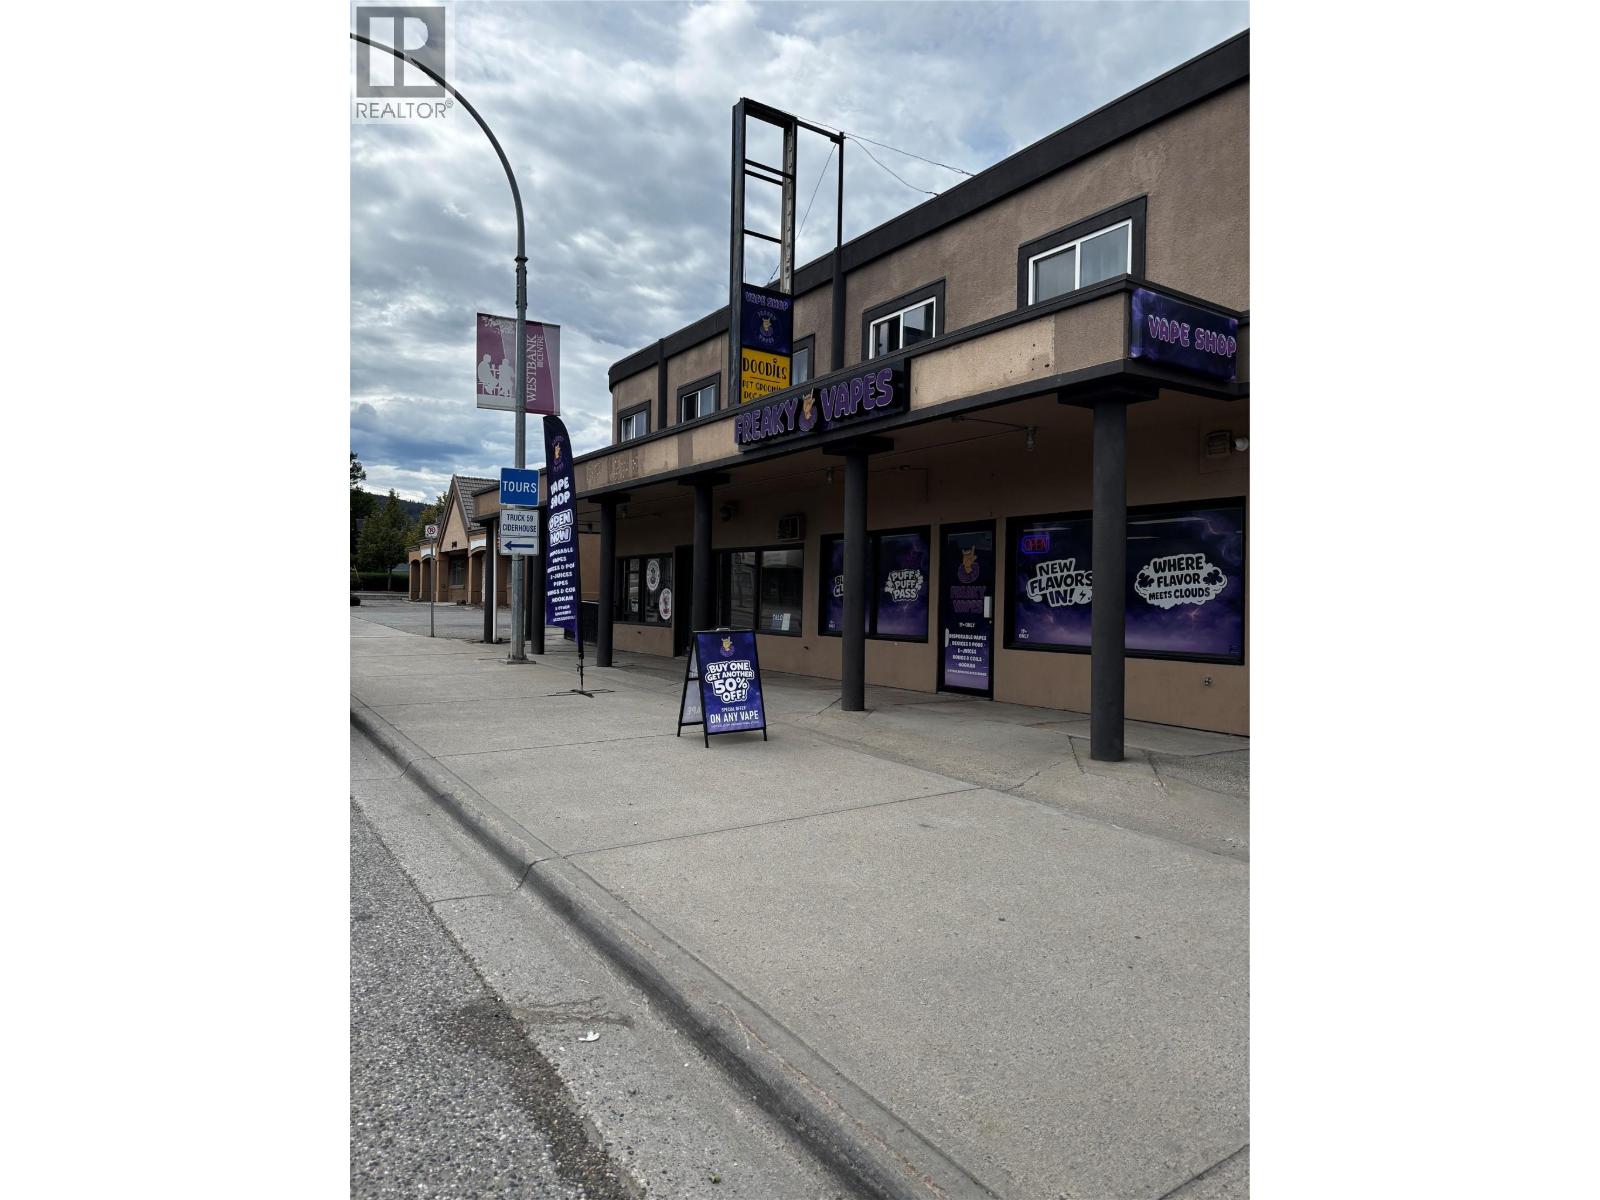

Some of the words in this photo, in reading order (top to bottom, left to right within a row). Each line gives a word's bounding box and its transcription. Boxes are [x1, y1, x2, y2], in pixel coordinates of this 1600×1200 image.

[1148, 314, 1190, 347] VAPE
[1195, 328, 1236, 358] SHOP
[536, 334, 544, 361] CENTRE
[526, 334, 537, 402] WESTBANK
[743, 380, 754, 389] PET
[735, 397, 798, 444] FREAKY
[820, 368, 894, 422] VAPES
[502, 480, 537, 493] TOURS
[507, 513, 525, 522] TRUCK
[549, 511, 571, 530] OPEN
[502, 524, 537, 533] CIDERHOUSE
[550, 528, 569, 545] NOW
[1024, 537, 1048, 551] OPEN
[1038, 560, 1073, 576] NEW
[1153, 555, 1204, 573] WHERE
[553, 579, 568, 587] PIPES
[894, 580, 915, 589] PUFF
[1029, 572, 1092, 594] FLAVORS
[1156, 572, 1200, 588] FLAVOR
[893, 588, 916, 599] PASS
[1048, 588, 1075, 605] IN!
[1148, 590, 1173, 601] MEETS
[1173, 587, 1211, 599] CLOUDS
[708, 663, 728, 673] BUY
[729, 662, 750, 671] ONE
[707, 673, 721, 682] GET
[722, 670, 753, 678] ANOTHER
[714, 677, 747, 694] 50%
[722, 689, 746, 702] OFF!
[710, 713, 721, 724] ON
[723, 711, 738, 722] ANY
[739, 709, 759, 721] VAPE
